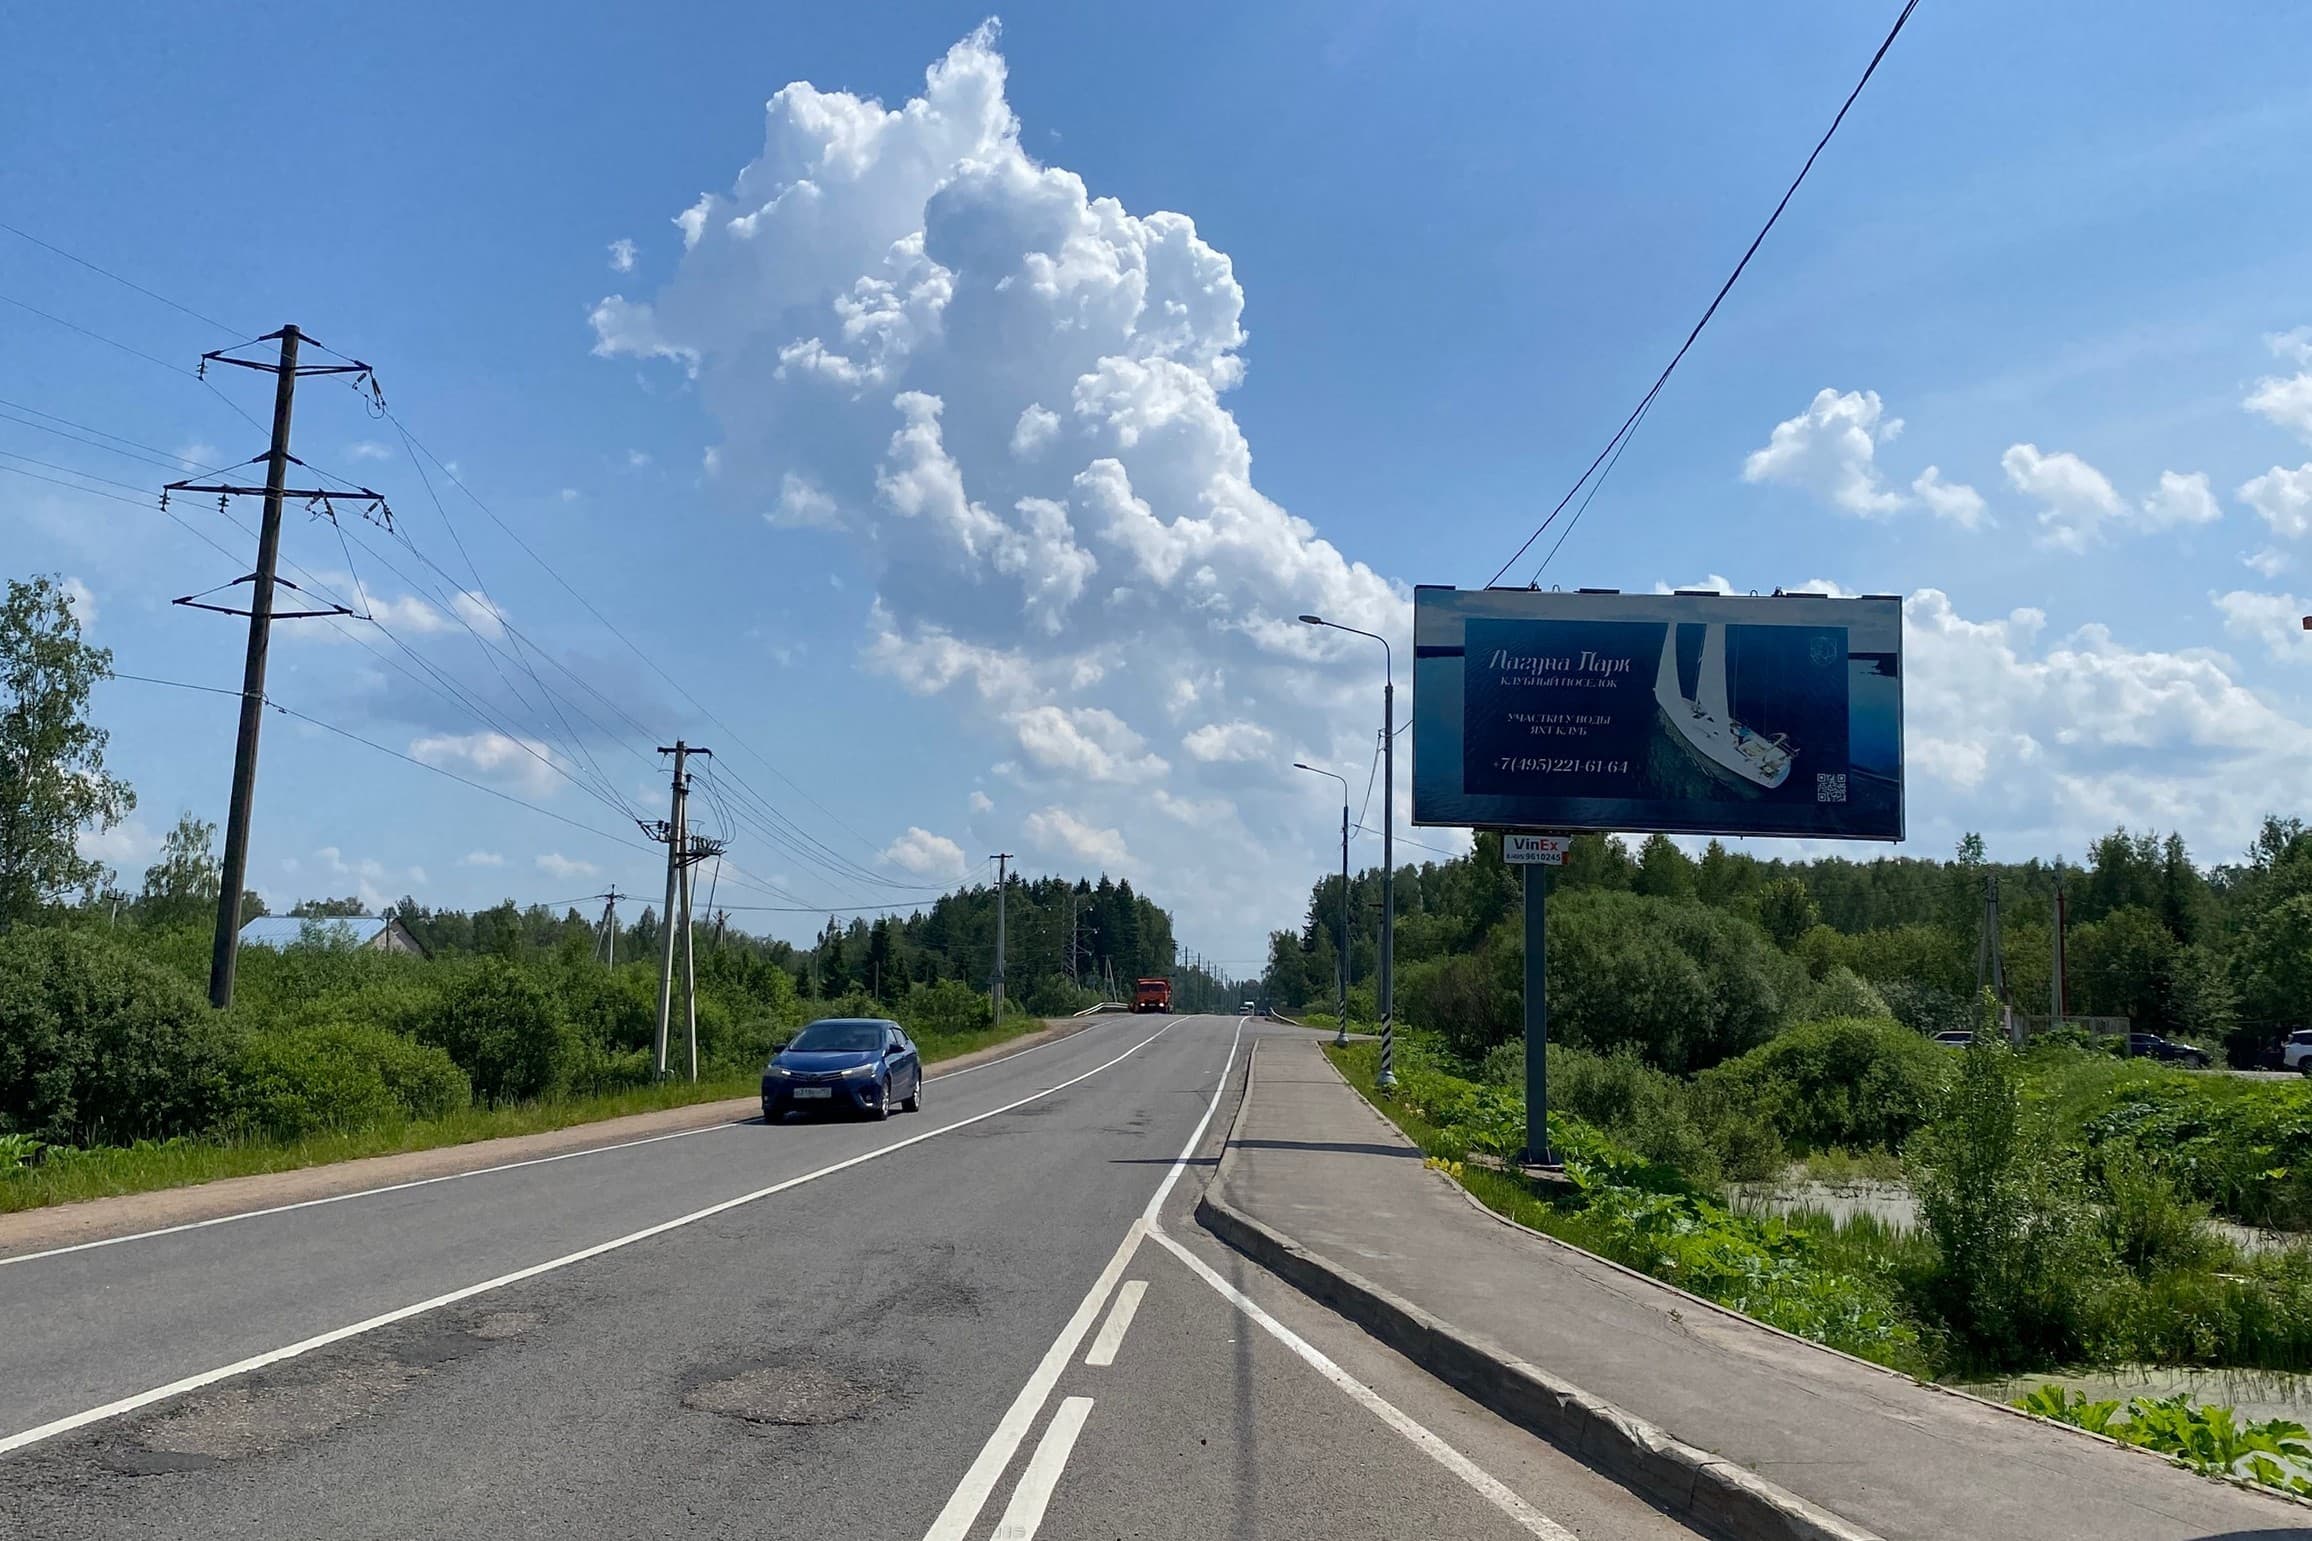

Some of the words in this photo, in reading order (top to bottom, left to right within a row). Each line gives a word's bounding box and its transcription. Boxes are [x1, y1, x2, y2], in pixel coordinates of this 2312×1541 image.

[1489, 649, 1570, 676] Лагуна
[1578, 651, 1632, 677] Парк
[1500, 676, 1560, 686] КЛУБНЫЙ
[1507, 713, 1563, 723] УЧАСТКИ
[1564, 714, 1574, 723] У
[1575, 714, 1611, 725] ВОДЫ
[1530, 726, 1553, 735] ЯХТ
[1556, 726, 1588, 735] КЛУБ
[1514, 838, 1558, 851] VinEx
